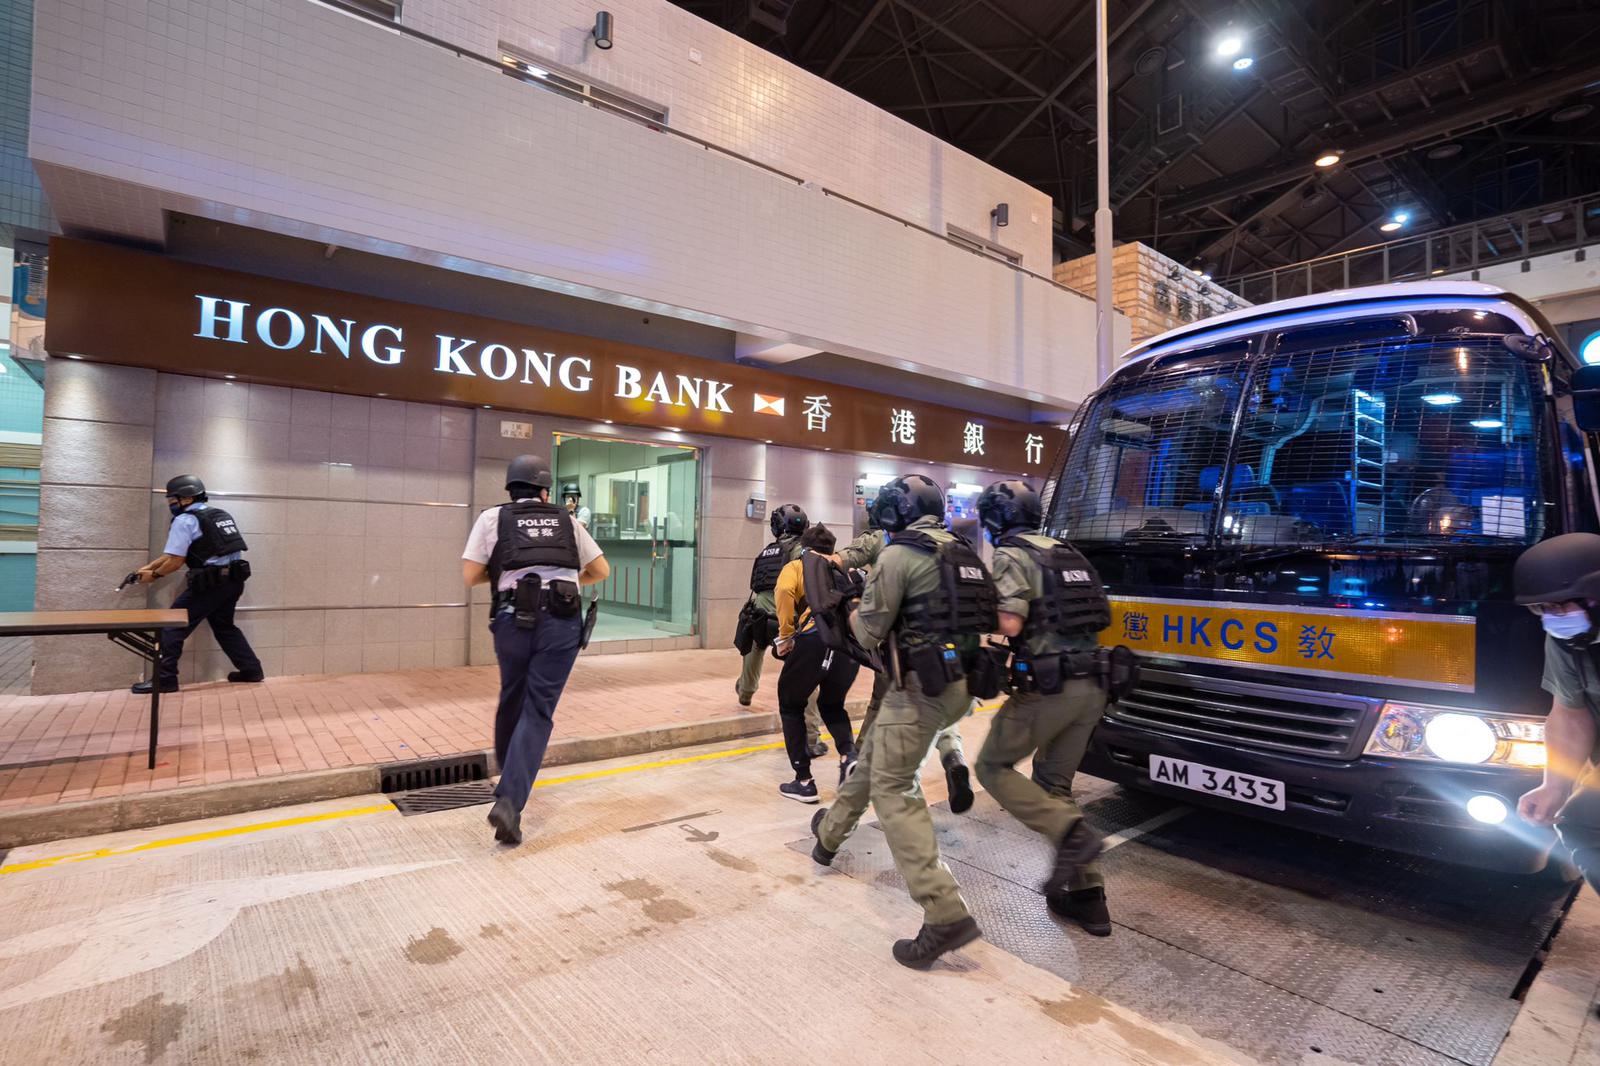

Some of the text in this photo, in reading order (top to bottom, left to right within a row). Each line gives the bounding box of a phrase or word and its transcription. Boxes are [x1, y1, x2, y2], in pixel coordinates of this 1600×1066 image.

[193, 294, 734, 414] HONG KONG BANK
[802, 395, 1044, 465] 香港銀行
[517, 518, 560, 527] POLICE
[1122, 611, 1336, 660] 懲 HKCS 教
[1156, 760, 1278, 805] AM 3433
